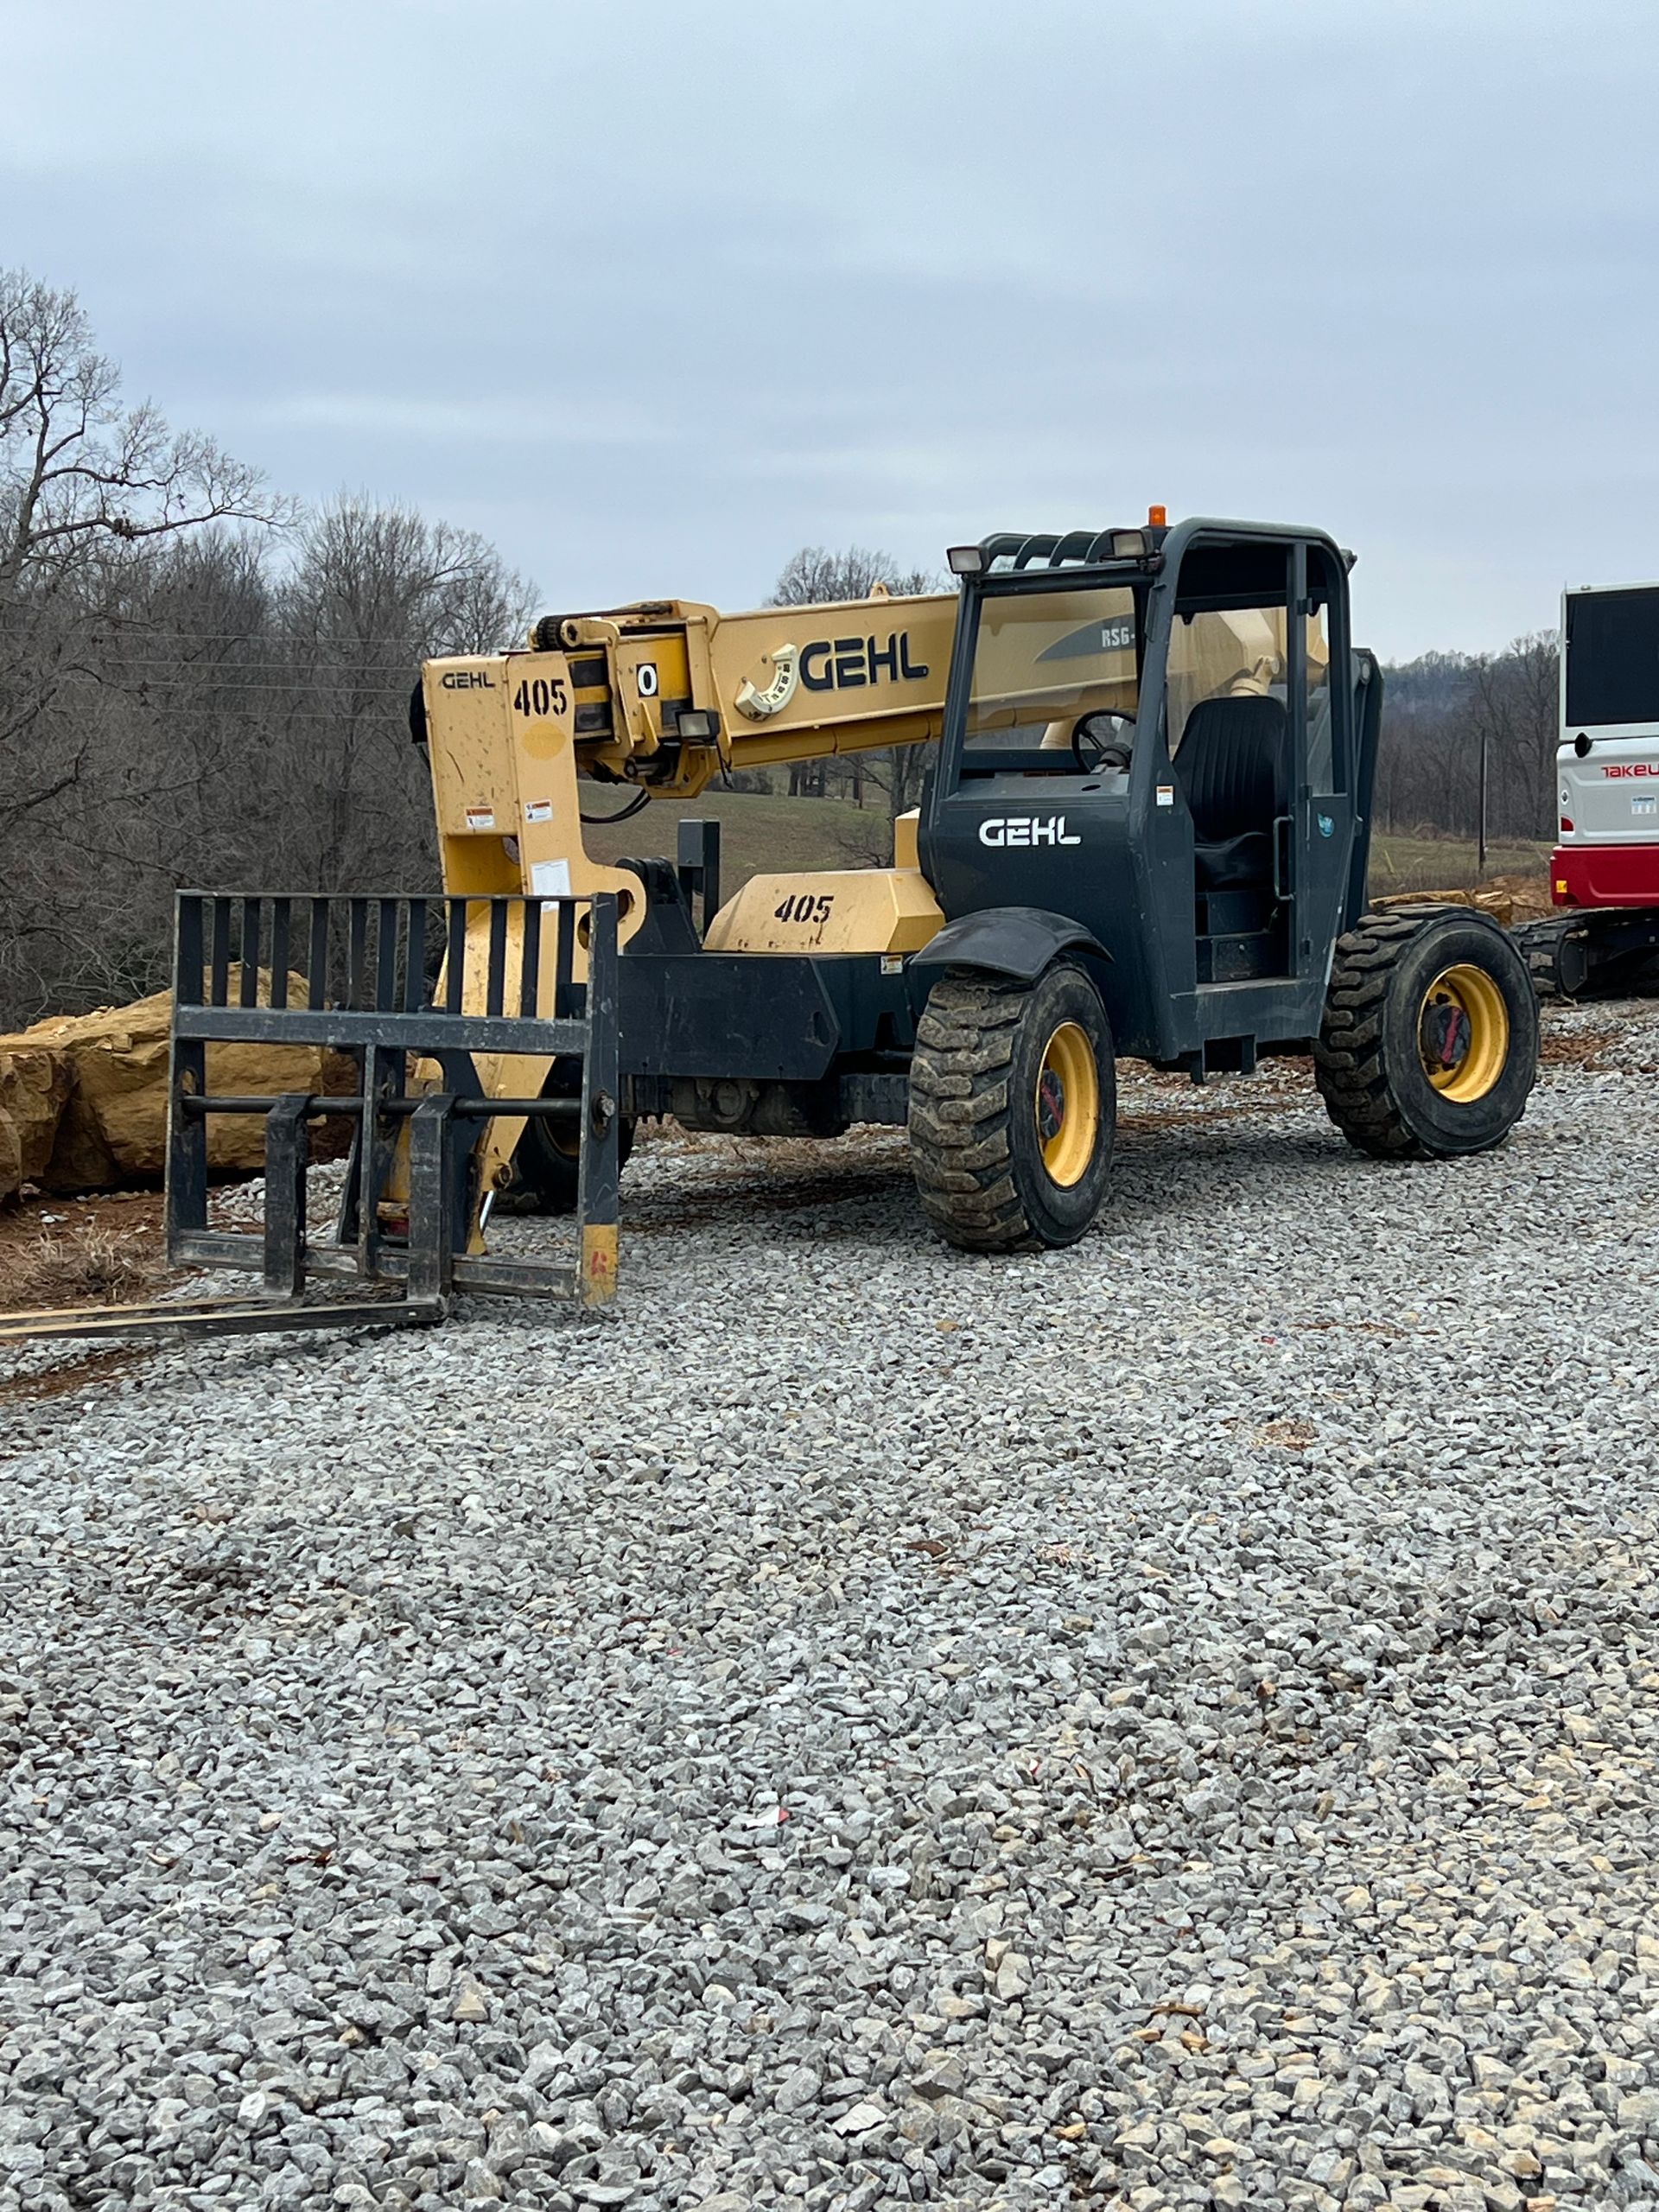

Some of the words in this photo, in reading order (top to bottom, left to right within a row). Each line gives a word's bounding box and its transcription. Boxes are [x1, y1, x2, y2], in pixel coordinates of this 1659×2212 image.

[799, 632, 929, 691] GEHL
[442, 671, 496, 690] GEHL
[513, 678, 567, 716] 405
[979, 816, 1081, 847] GEHL
[774, 894, 835, 923] 405
